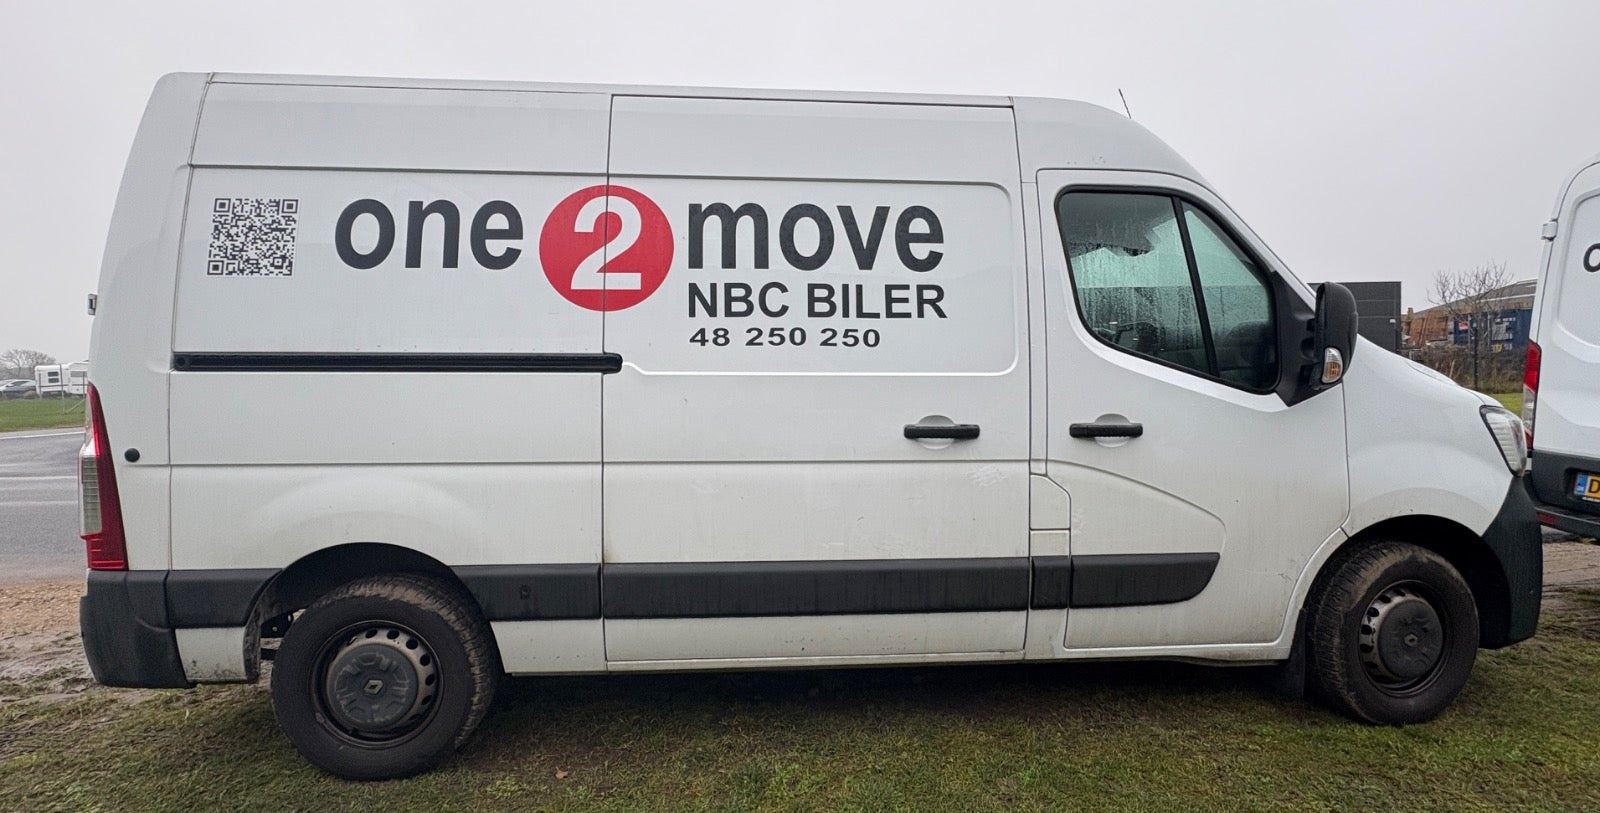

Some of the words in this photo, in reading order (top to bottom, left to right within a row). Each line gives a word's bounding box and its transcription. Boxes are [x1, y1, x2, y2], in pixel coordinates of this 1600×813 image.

[335, 198, 524, 271] one
[570, 195, 643, 290] 2
[688, 203, 944, 272] move
[688, 282, 790, 318] NBC
[807, 283, 948, 319] BILER
[689, 327, 730, 347] 48
[746, 327, 807, 347] 250
[820, 328, 881, 348] 250
